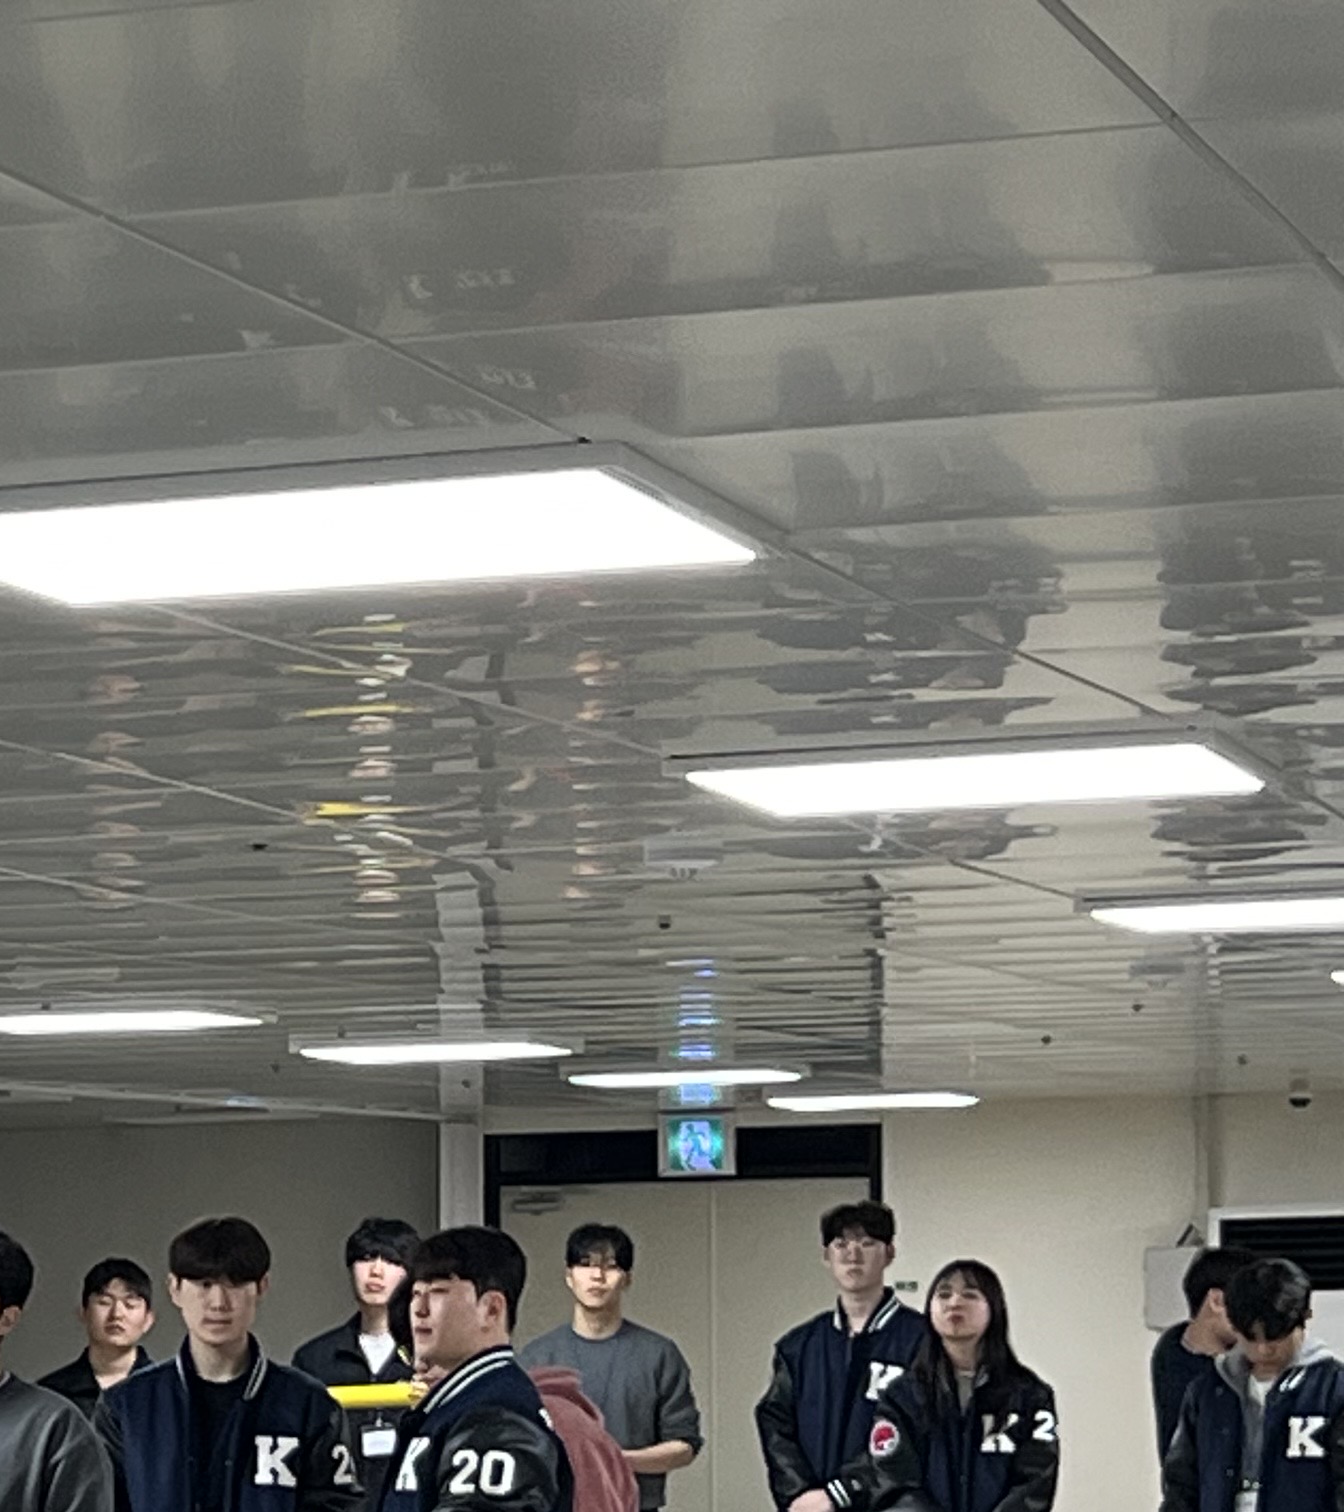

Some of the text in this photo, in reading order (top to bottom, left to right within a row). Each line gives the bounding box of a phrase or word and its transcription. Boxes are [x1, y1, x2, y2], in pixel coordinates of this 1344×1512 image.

[980, 1413, 1019, 1454] K
[1286, 1416, 1326, 1458] K
[254, 1435, 299, 1487] K
[448, 1449, 516, 1496] 20
